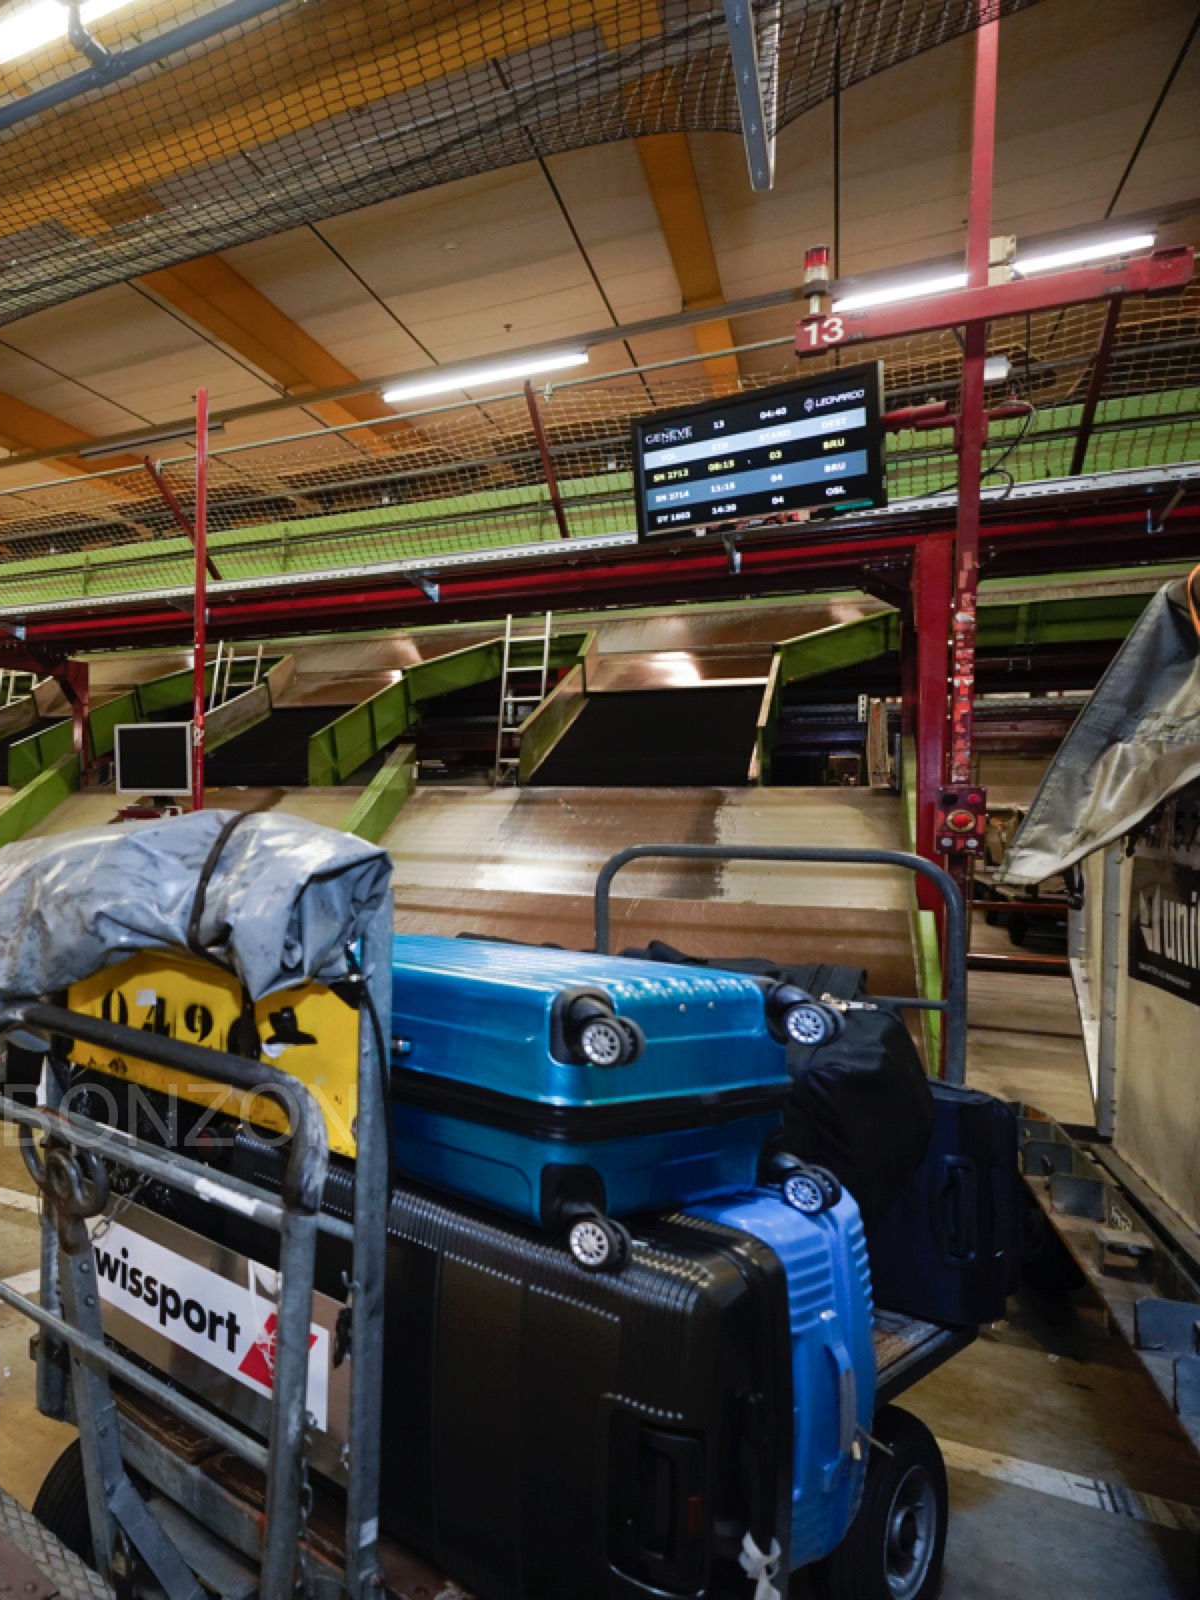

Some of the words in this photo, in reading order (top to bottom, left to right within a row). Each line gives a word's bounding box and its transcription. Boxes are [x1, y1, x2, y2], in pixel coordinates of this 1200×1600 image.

[803, 317, 844, 345] 13
[815, 389, 865, 407] LEONARDO
[759, 429, 790, 442] STAND
[821, 417, 847, 429] DEST
[822, 437, 845, 450] BRU
[824, 461, 846, 473] BRU
